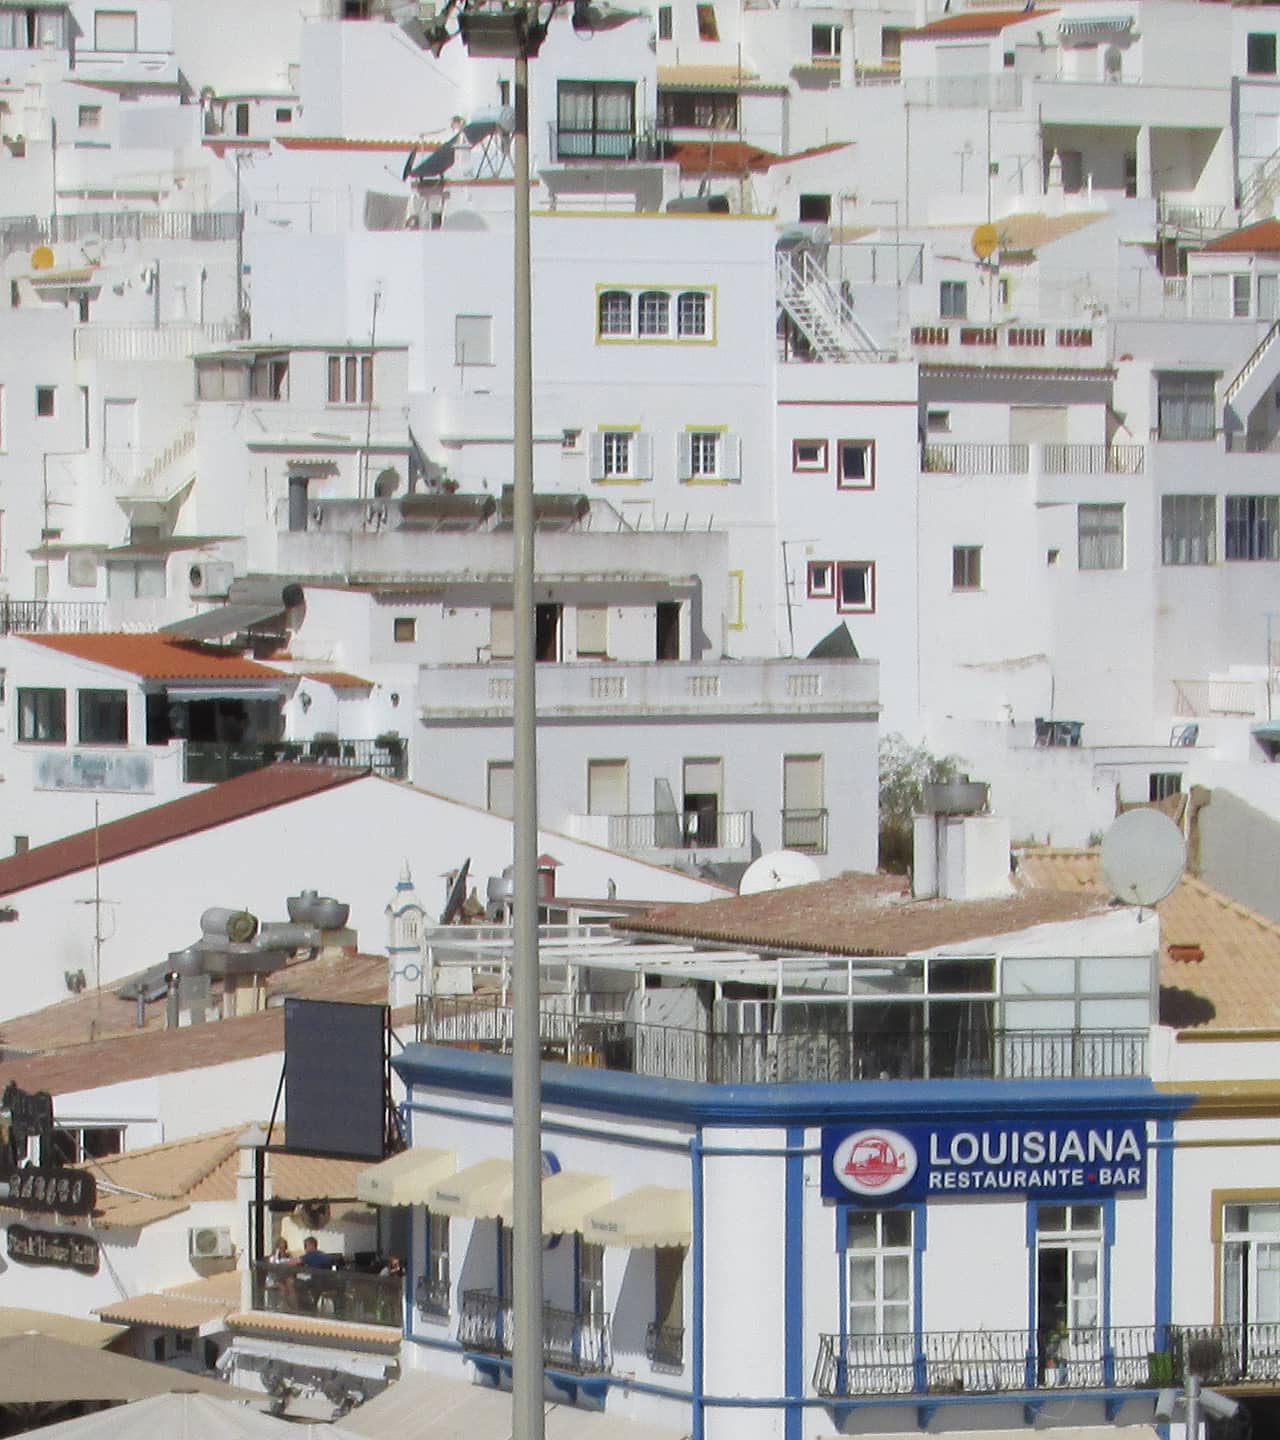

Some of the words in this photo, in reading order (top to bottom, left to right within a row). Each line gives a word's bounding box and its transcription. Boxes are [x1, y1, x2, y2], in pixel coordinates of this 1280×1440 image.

[929, 1129, 1142, 1166] LOUISIANA
[928, 1169, 1084, 1189] RESTAURANTE
[1099, 1167, 1141, 1186] BAR
